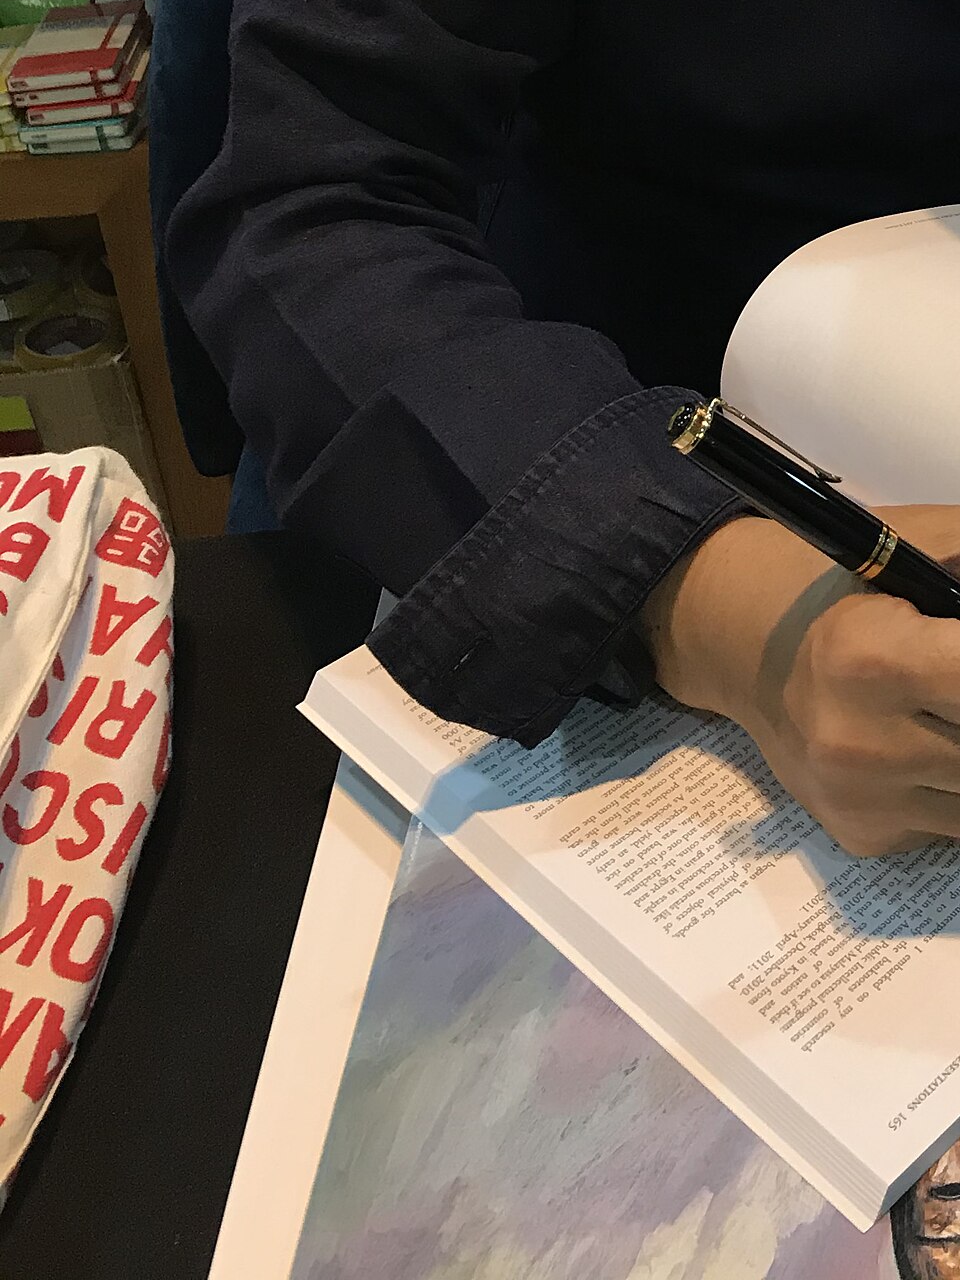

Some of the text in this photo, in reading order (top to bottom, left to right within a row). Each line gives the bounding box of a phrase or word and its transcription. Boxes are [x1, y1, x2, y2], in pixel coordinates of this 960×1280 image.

[771, 839, 799, 861] money
[749, 860, 775, 880] began
[862, 857, 904, 893] November
[739, 879, 748, 888] as
[799, 859, 862, 913] April-June 2011.
[887, 874, 903, 887] To
[906, 870, 943, 904] Thailand,
[714, 887, 741, 907] barter
[840, 892, 865, 914] 2010;
[872, 887, 889, 901] this
[921, 899, 931, 908] in
[700, 906, 715, 917] for
[854, 901, 872, 917] end,
[908, 907, 923, 921] the
[935, 902, 946, 912] to
[670, 915, 699, 938] goods,
[758, 839, 956, 1017] designs were also an expression of nation and
[775, 901, 834, 951] February-April
[803, 911, 843, 943] Bangkok,
[832, 921, 849, 935] was
[848, 916, 856, 924] I
[867, 902, 909, 936] Indonesia,
[908, 916, 931, 936] study
[885, 920, 910, 941] Asian
[808, 934, 835, 958] based:
[854, 936, 869, 953] and
[861, 939, 888, 962] Public
[892, 939, 907, 953] the
[914, 945, 922, 953] I
[763, 941, 806, 976] December
[797, 956, 809, 965] in
[819, 950, 856, 980] Malaysia
[727, 972, 745, 990] and
[770, 965, 799, 988] Kyoto
[817, 961, 863, 1002] Intellectual
[847, 955, 890, 992] banknotes
[872, 954, 910, 990] embarked
[810, 979, 821, 988] to
[748, 987, 773, 1006] from
[796, 987, 810, 1000] see
[832, 995, 843, 1008] of
[856, 991, 869, 1002] on
[788, 998, 799, 1009] if
[836, 1005, 853, 1018] my
[768, 1005, 791, 1024] their
[790, 1008, 828, 1043] countries
[801, 1021, 835, 1054] research
[887, 1112, 906, 1131] 165
